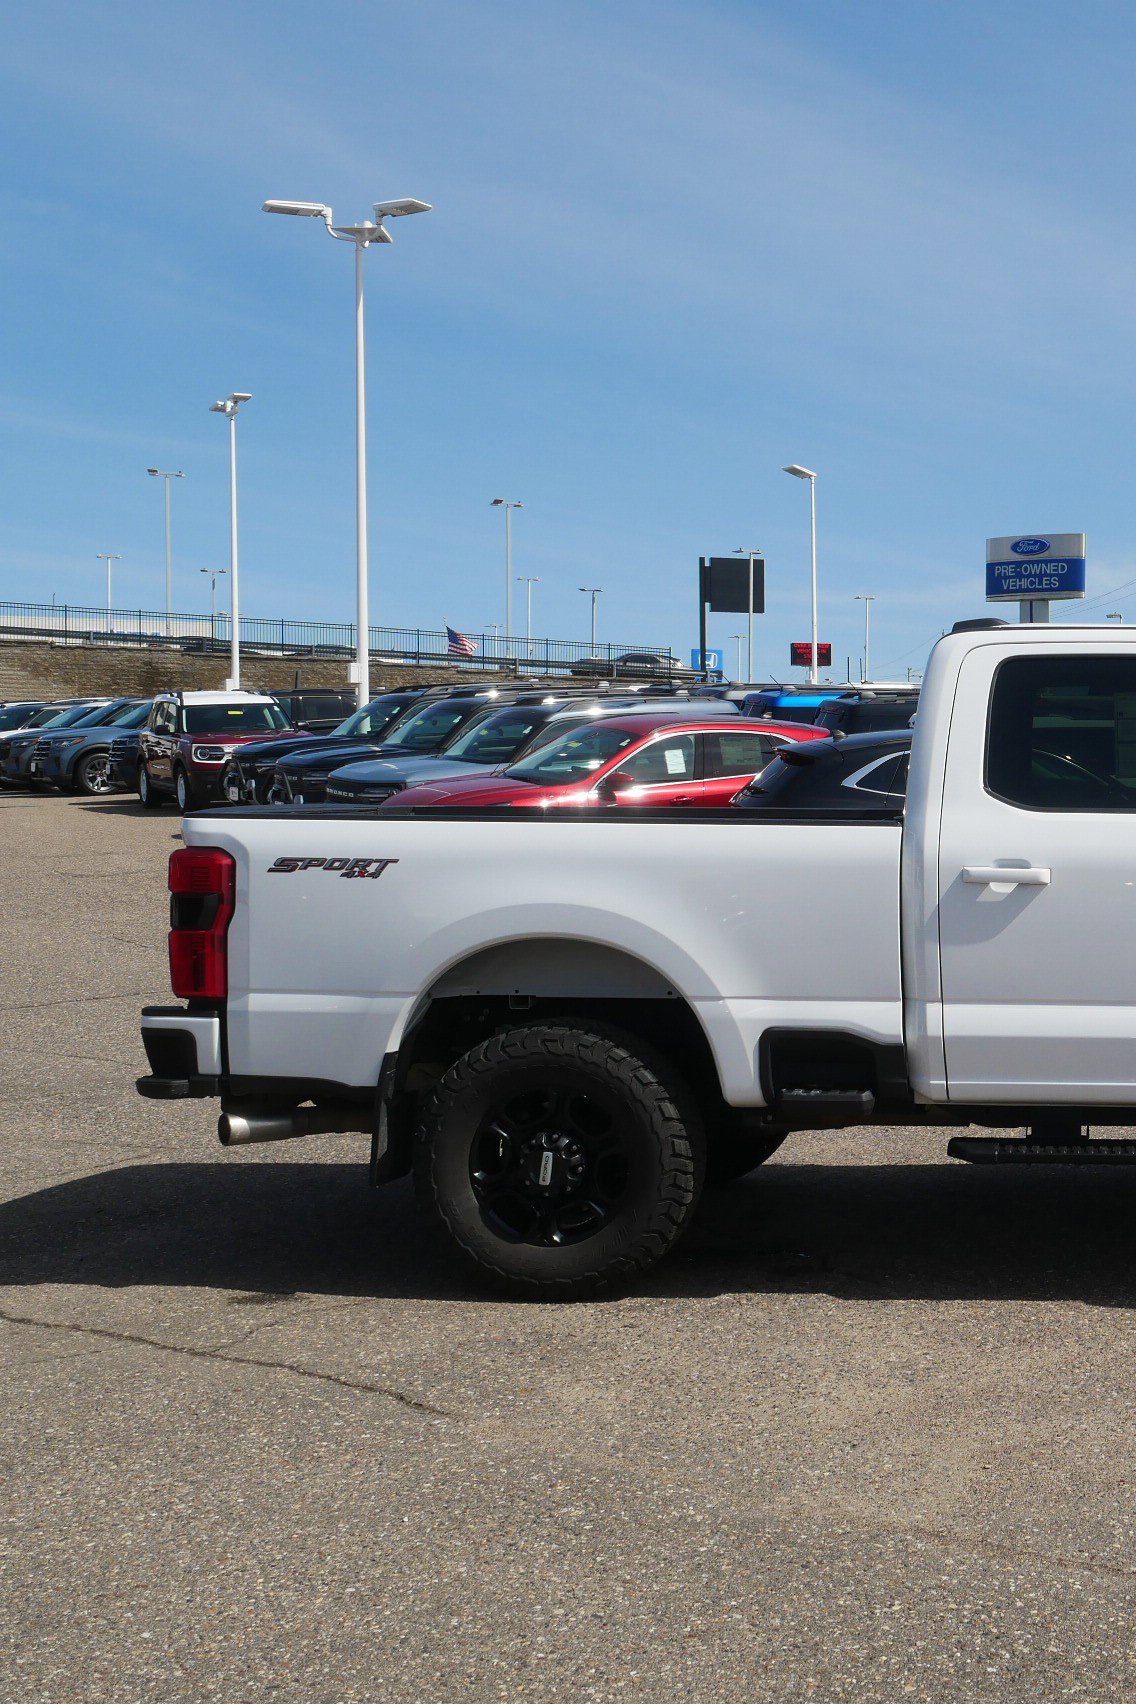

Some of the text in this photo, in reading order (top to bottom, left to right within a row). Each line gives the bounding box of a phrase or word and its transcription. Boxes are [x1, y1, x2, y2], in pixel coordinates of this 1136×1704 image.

[994, 562, 1068, 577] PRE-OWNED
[1002, 577, 1059, 590] VEHICLES
[326, 787, 354, 797] BRONCO
[266, 857, 400, 873] SPORT
